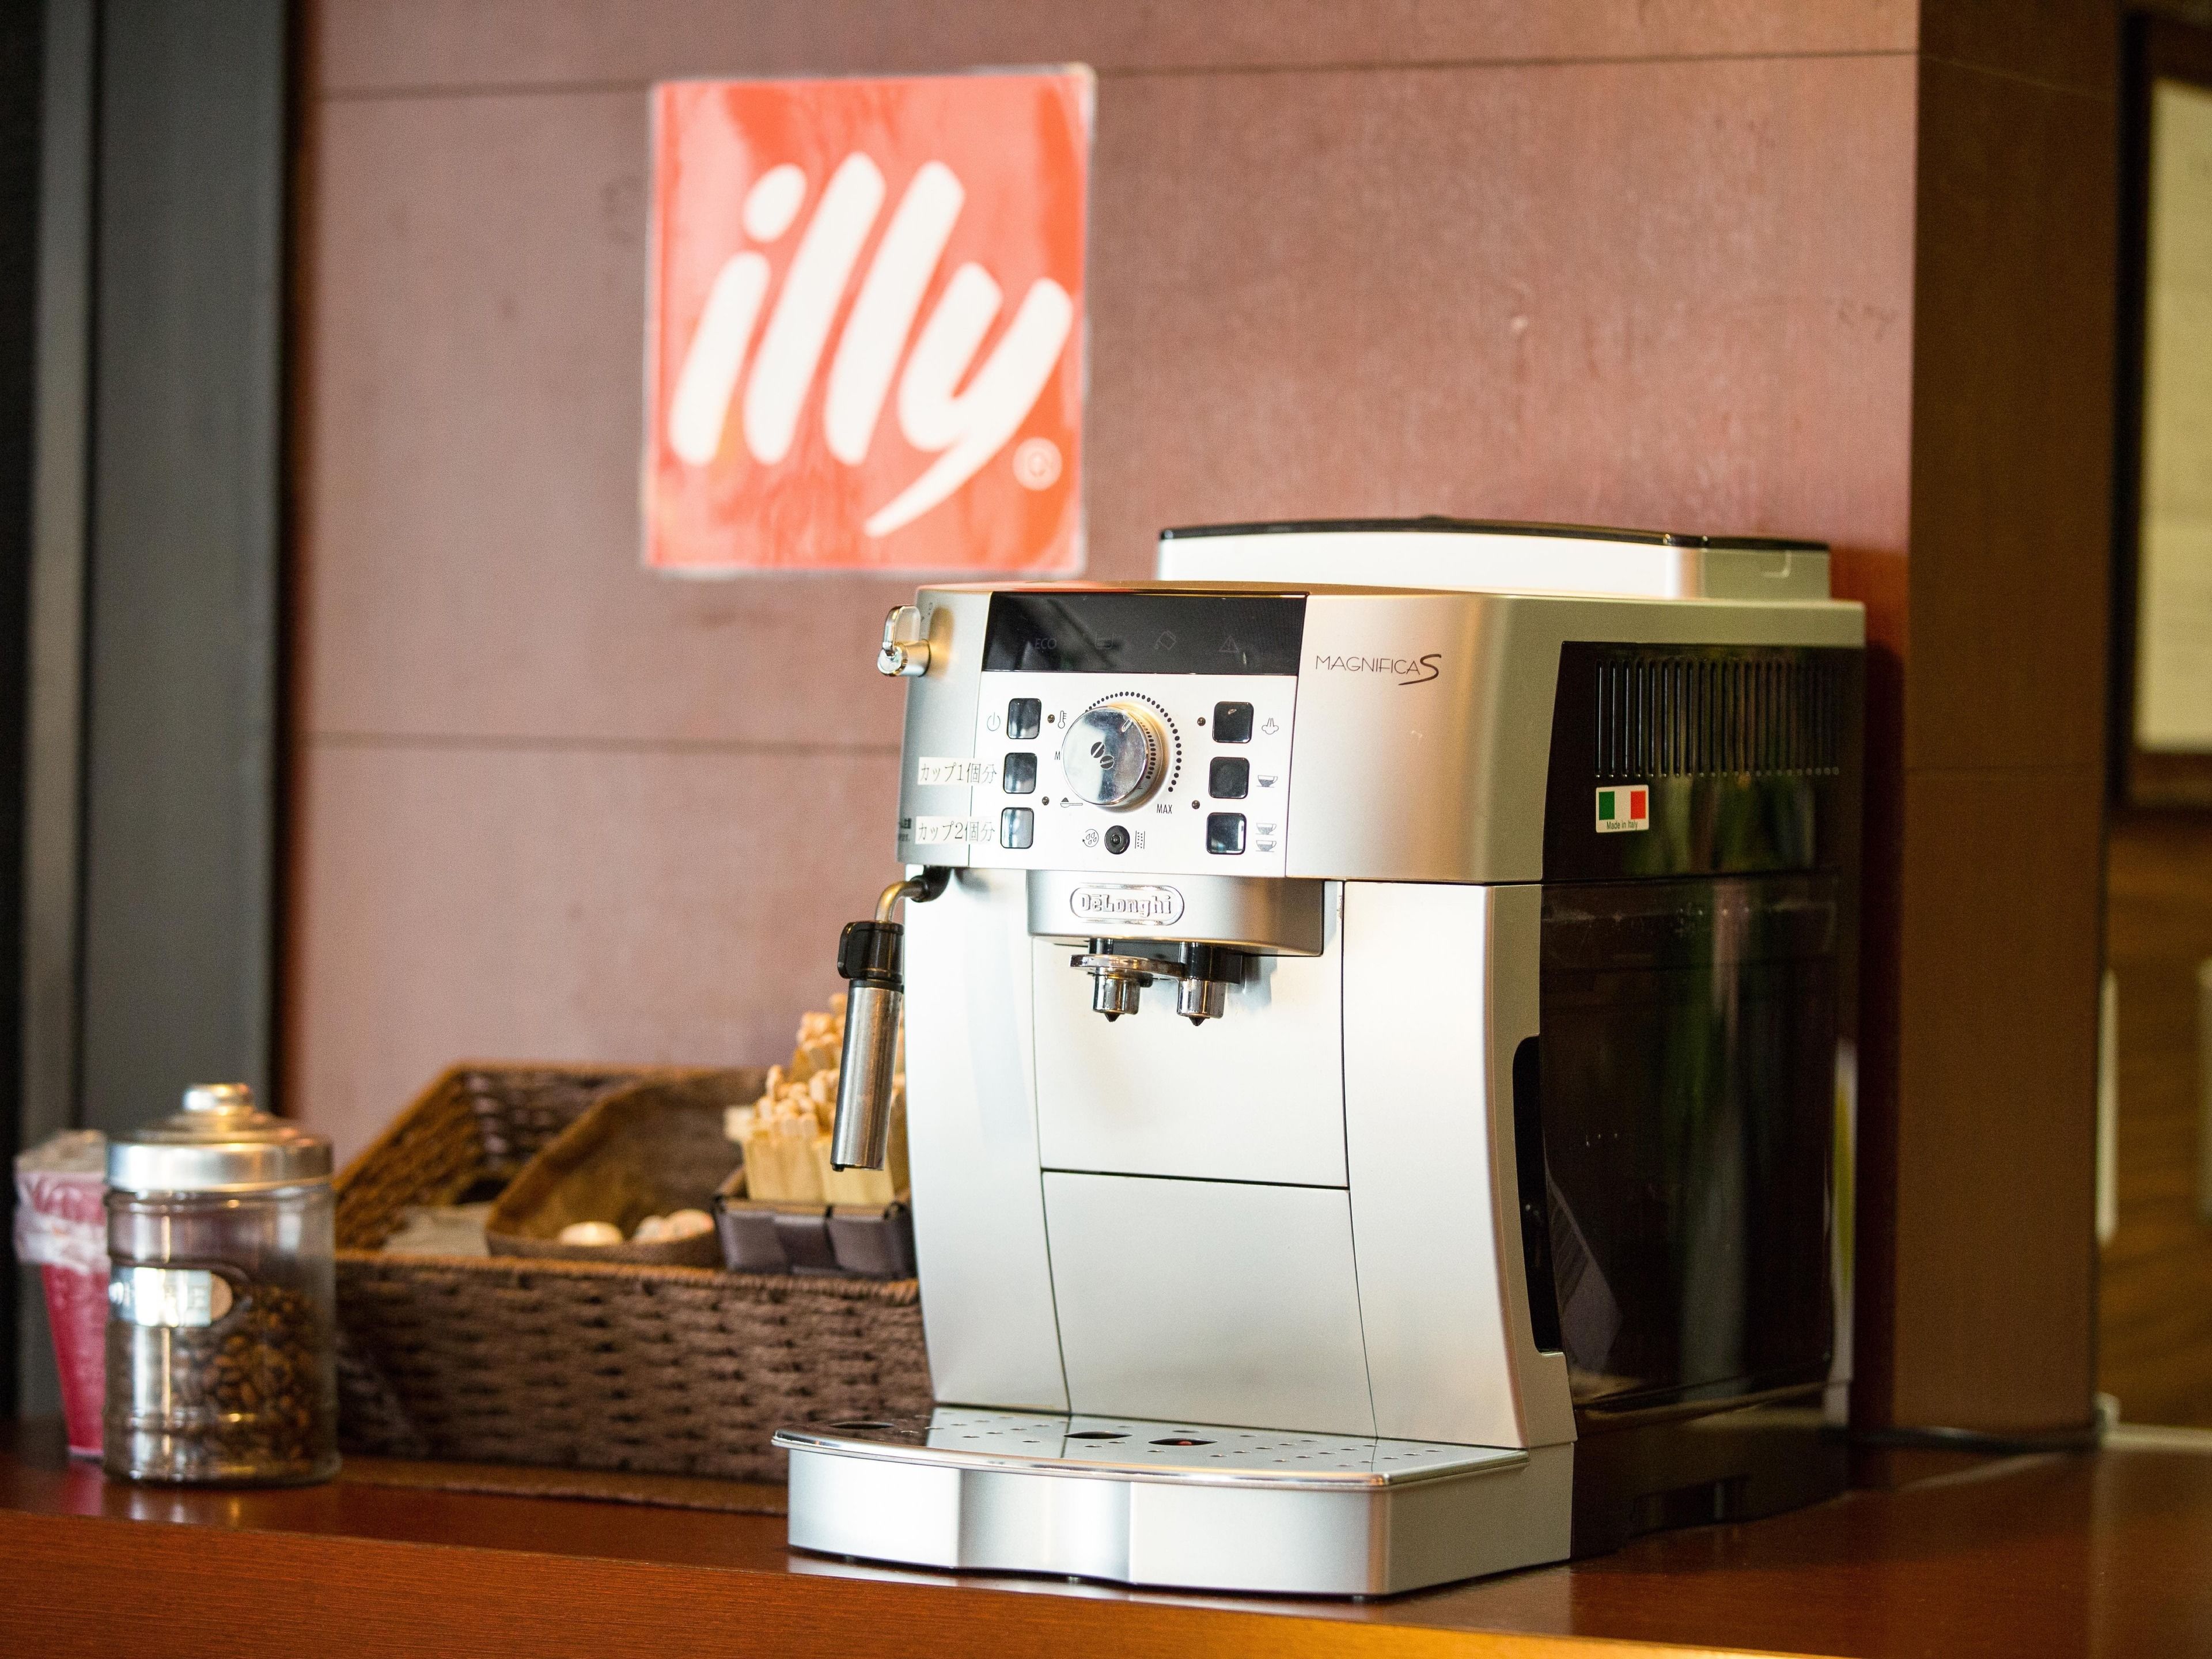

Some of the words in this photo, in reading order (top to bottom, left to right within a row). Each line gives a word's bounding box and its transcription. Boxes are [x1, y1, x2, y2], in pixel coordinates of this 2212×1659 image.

[669, 151, 1073, 538] illy
[1035, 637, 1057, 650] ECO
[920, 762, 997, 783] カップ1個分
[1156, 804, 1173, 815] MAX
[918, 821, 995, 842] カップ2個分
[1606, 821, 1620, 830] Made
[1628, 820, 1638, 830] Italy
